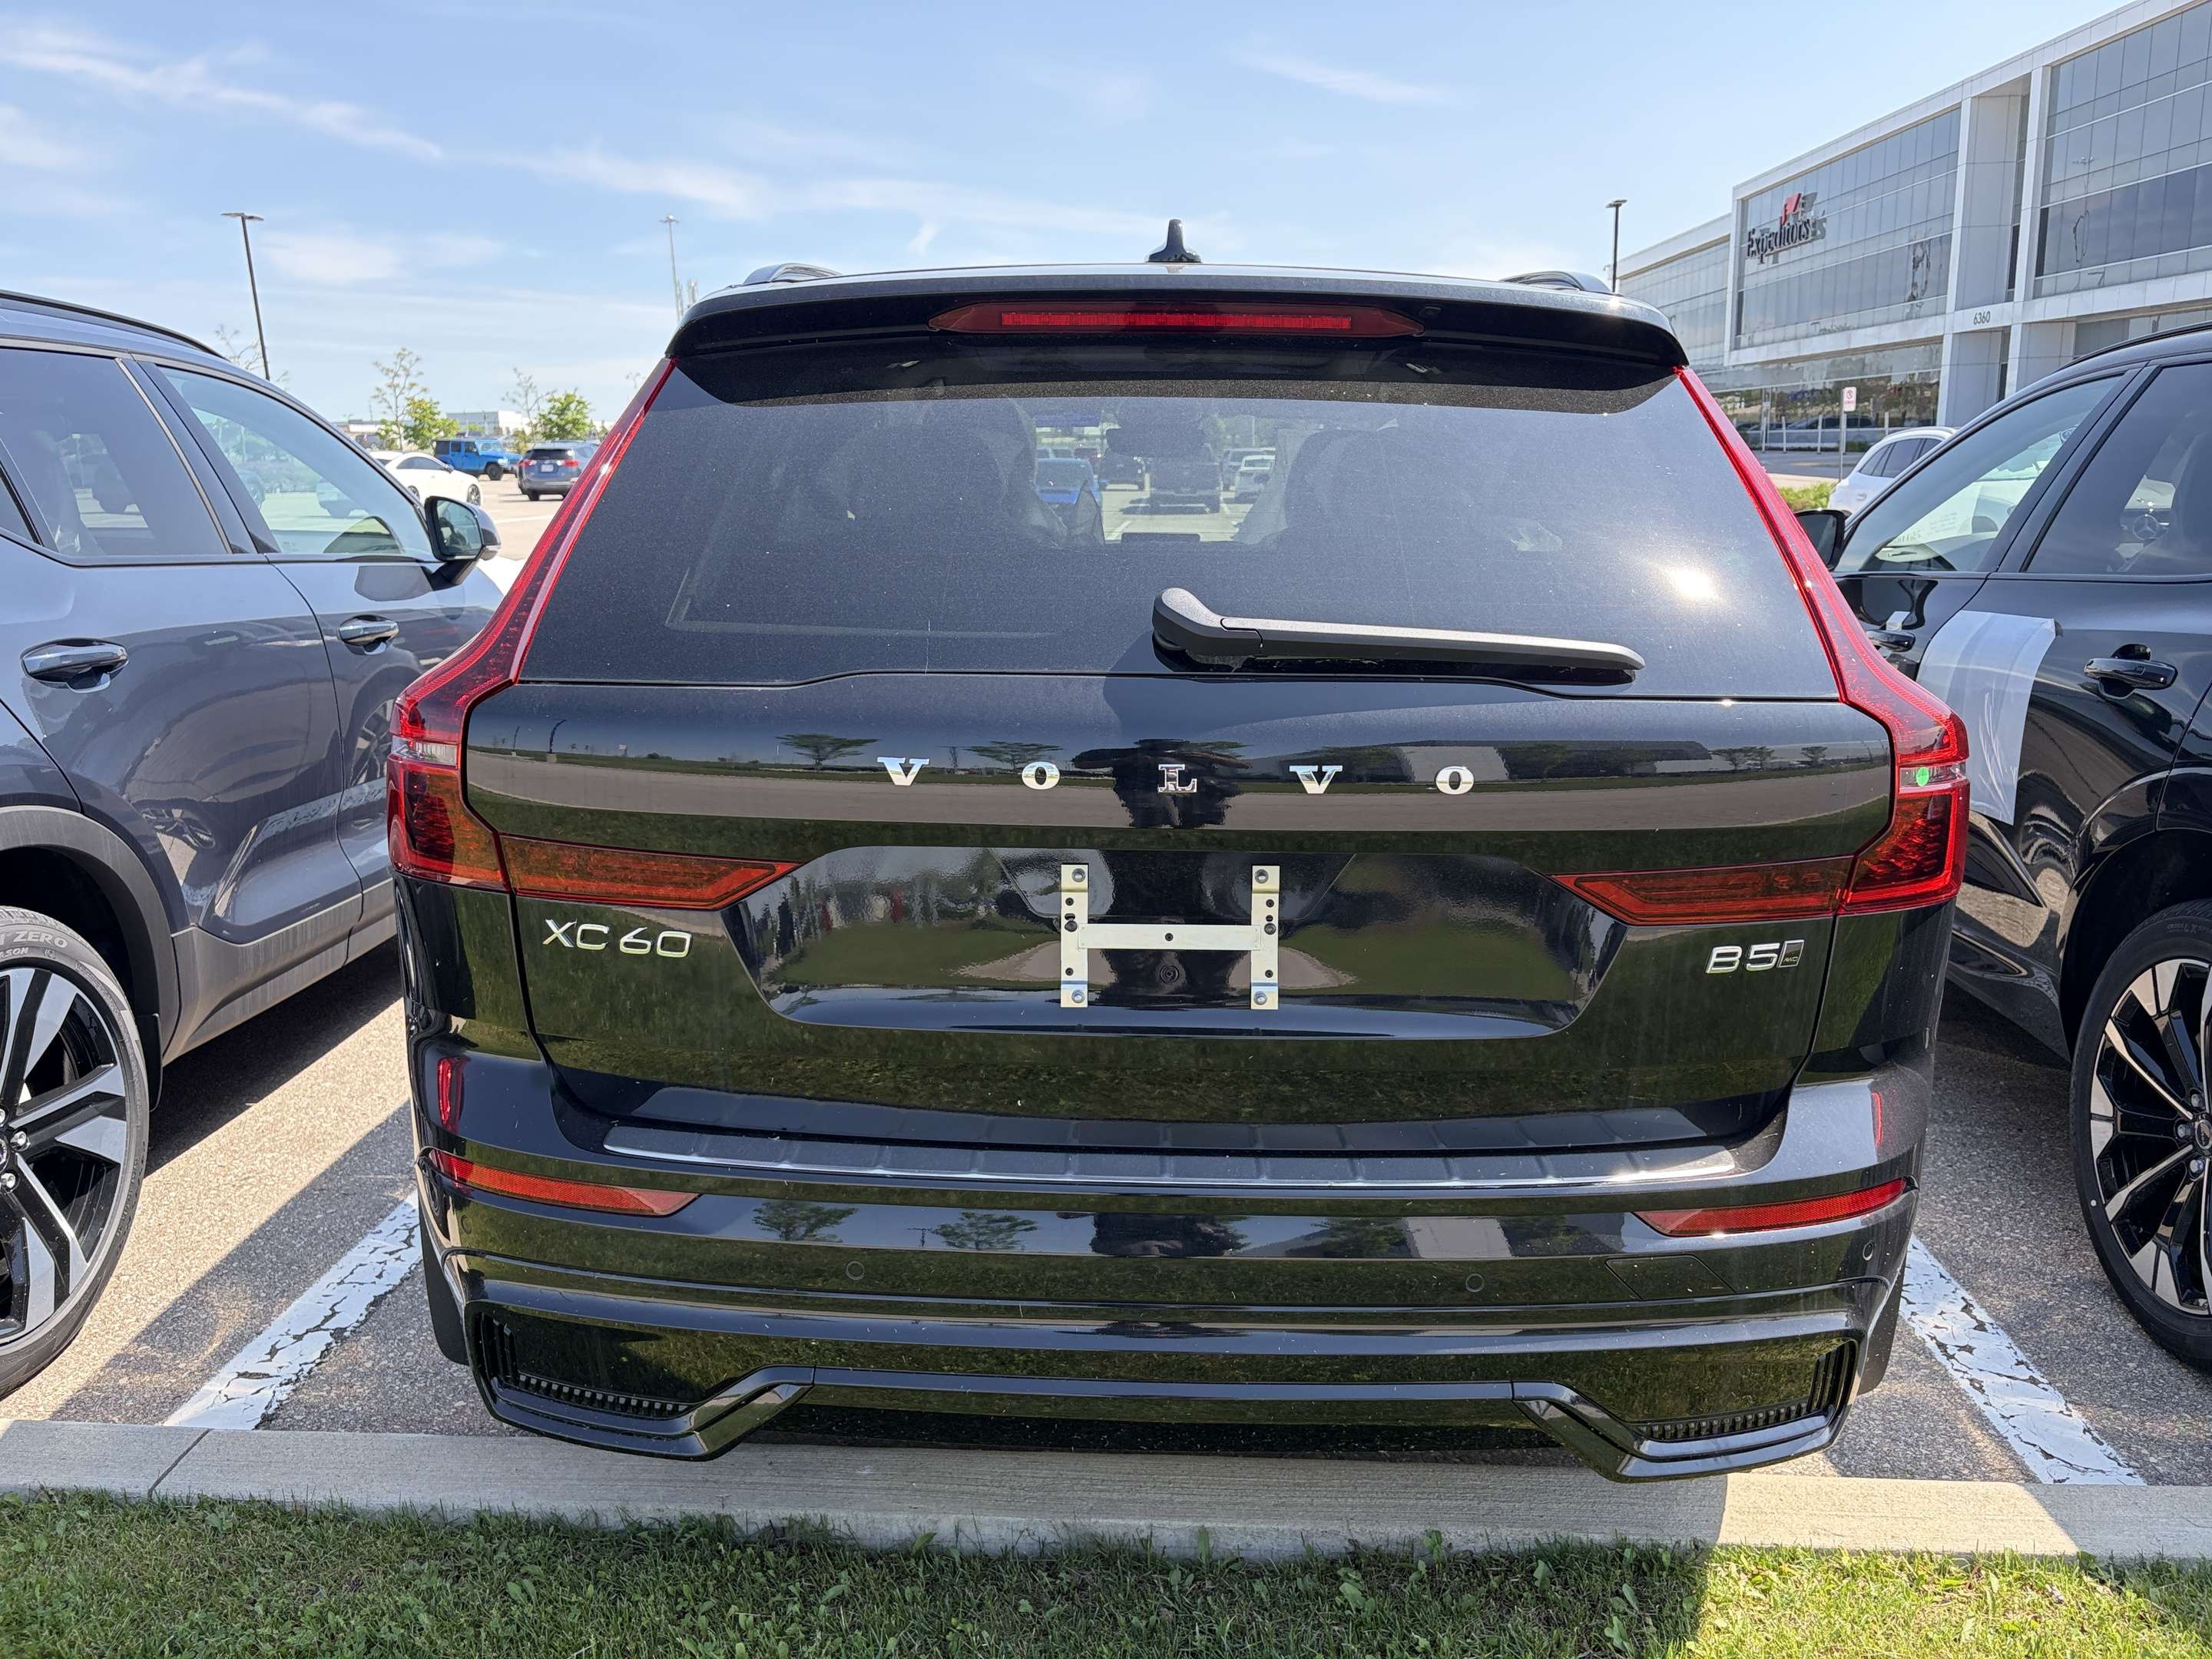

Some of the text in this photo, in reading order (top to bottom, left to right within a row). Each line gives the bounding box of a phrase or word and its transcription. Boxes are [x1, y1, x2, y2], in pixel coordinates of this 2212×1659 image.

[1747, 218, 1811, 264] Expeditors
[1973, 310, 1991, 325] 6360
[877, 757, 1475, 795] VOLVO
[13, 931, 68, 948] ZERO
[1706, 942, 1780, 974] B5
